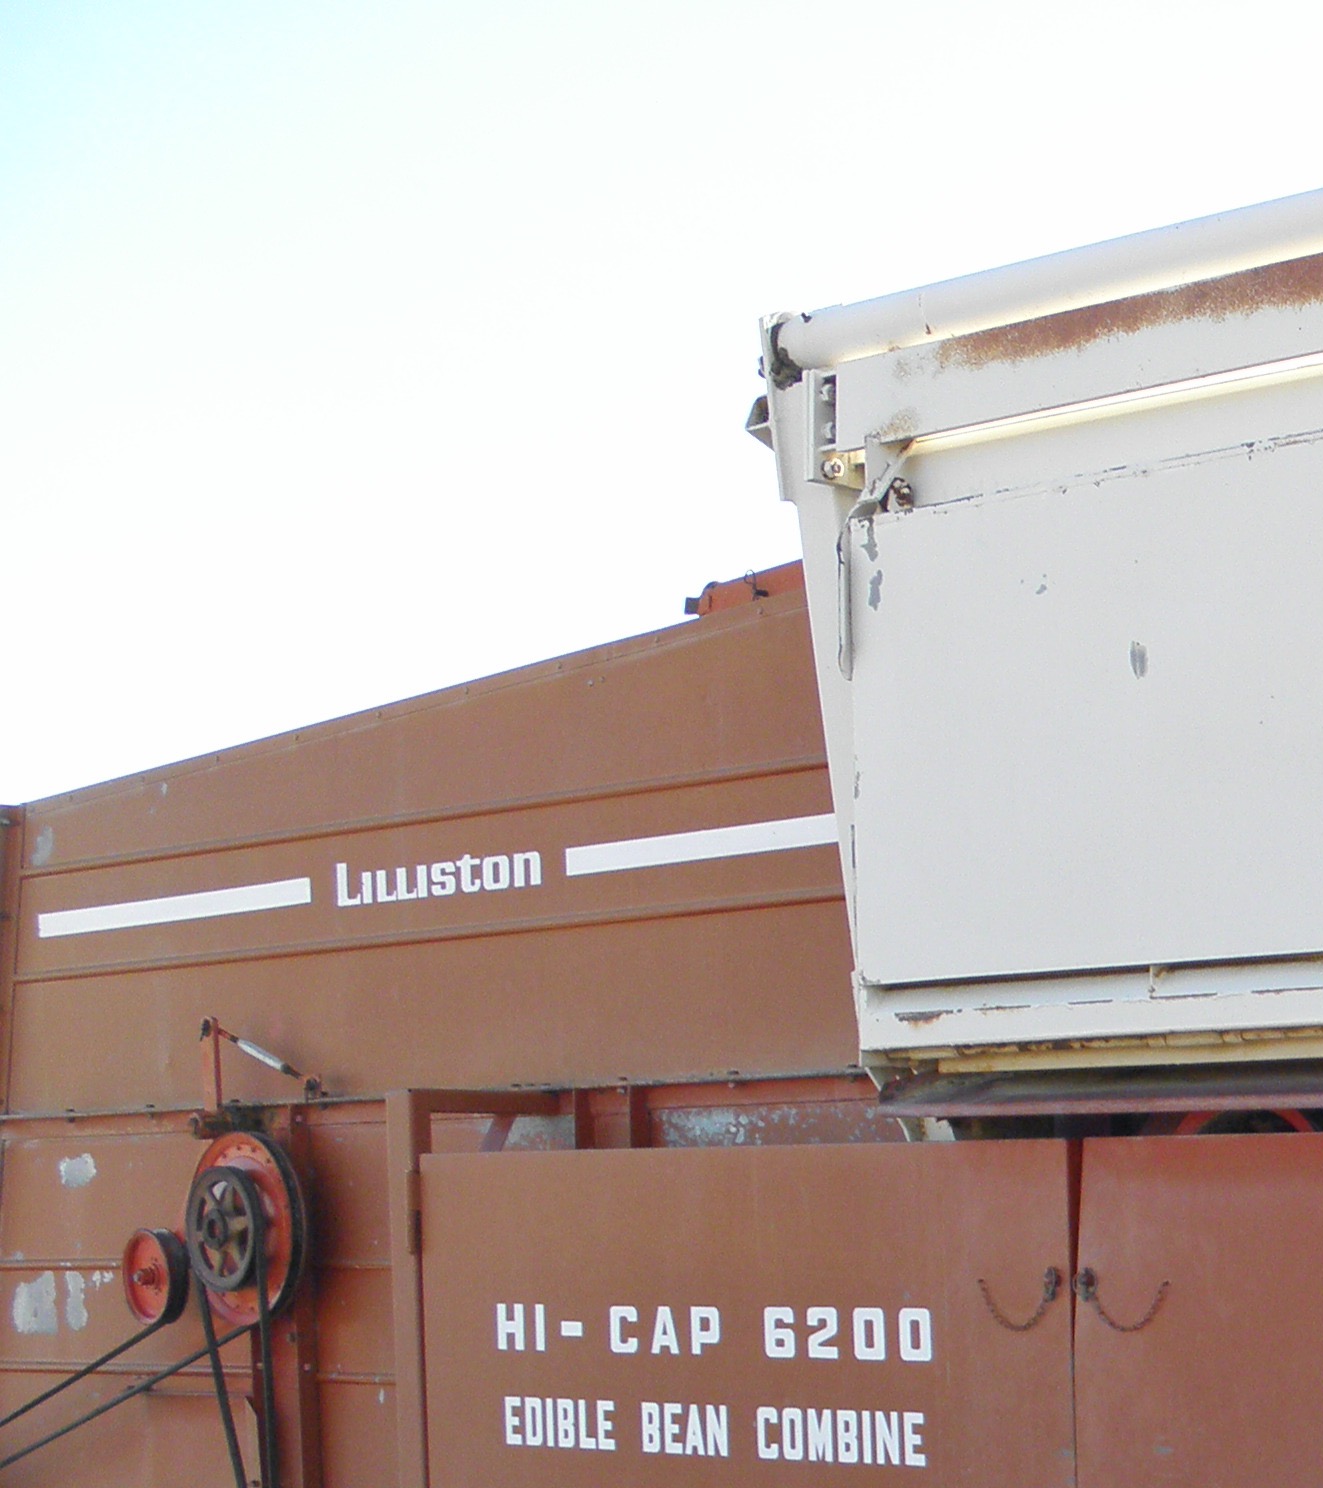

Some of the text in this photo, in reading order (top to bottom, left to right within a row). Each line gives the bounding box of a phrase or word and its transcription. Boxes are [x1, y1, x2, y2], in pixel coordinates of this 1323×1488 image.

[609, 1305, 721, 1355] CAP
[763, 1306, 932, 1361] 6200
[504, 1396, 926, 1466] EDIBLE BEAN COMBINE
